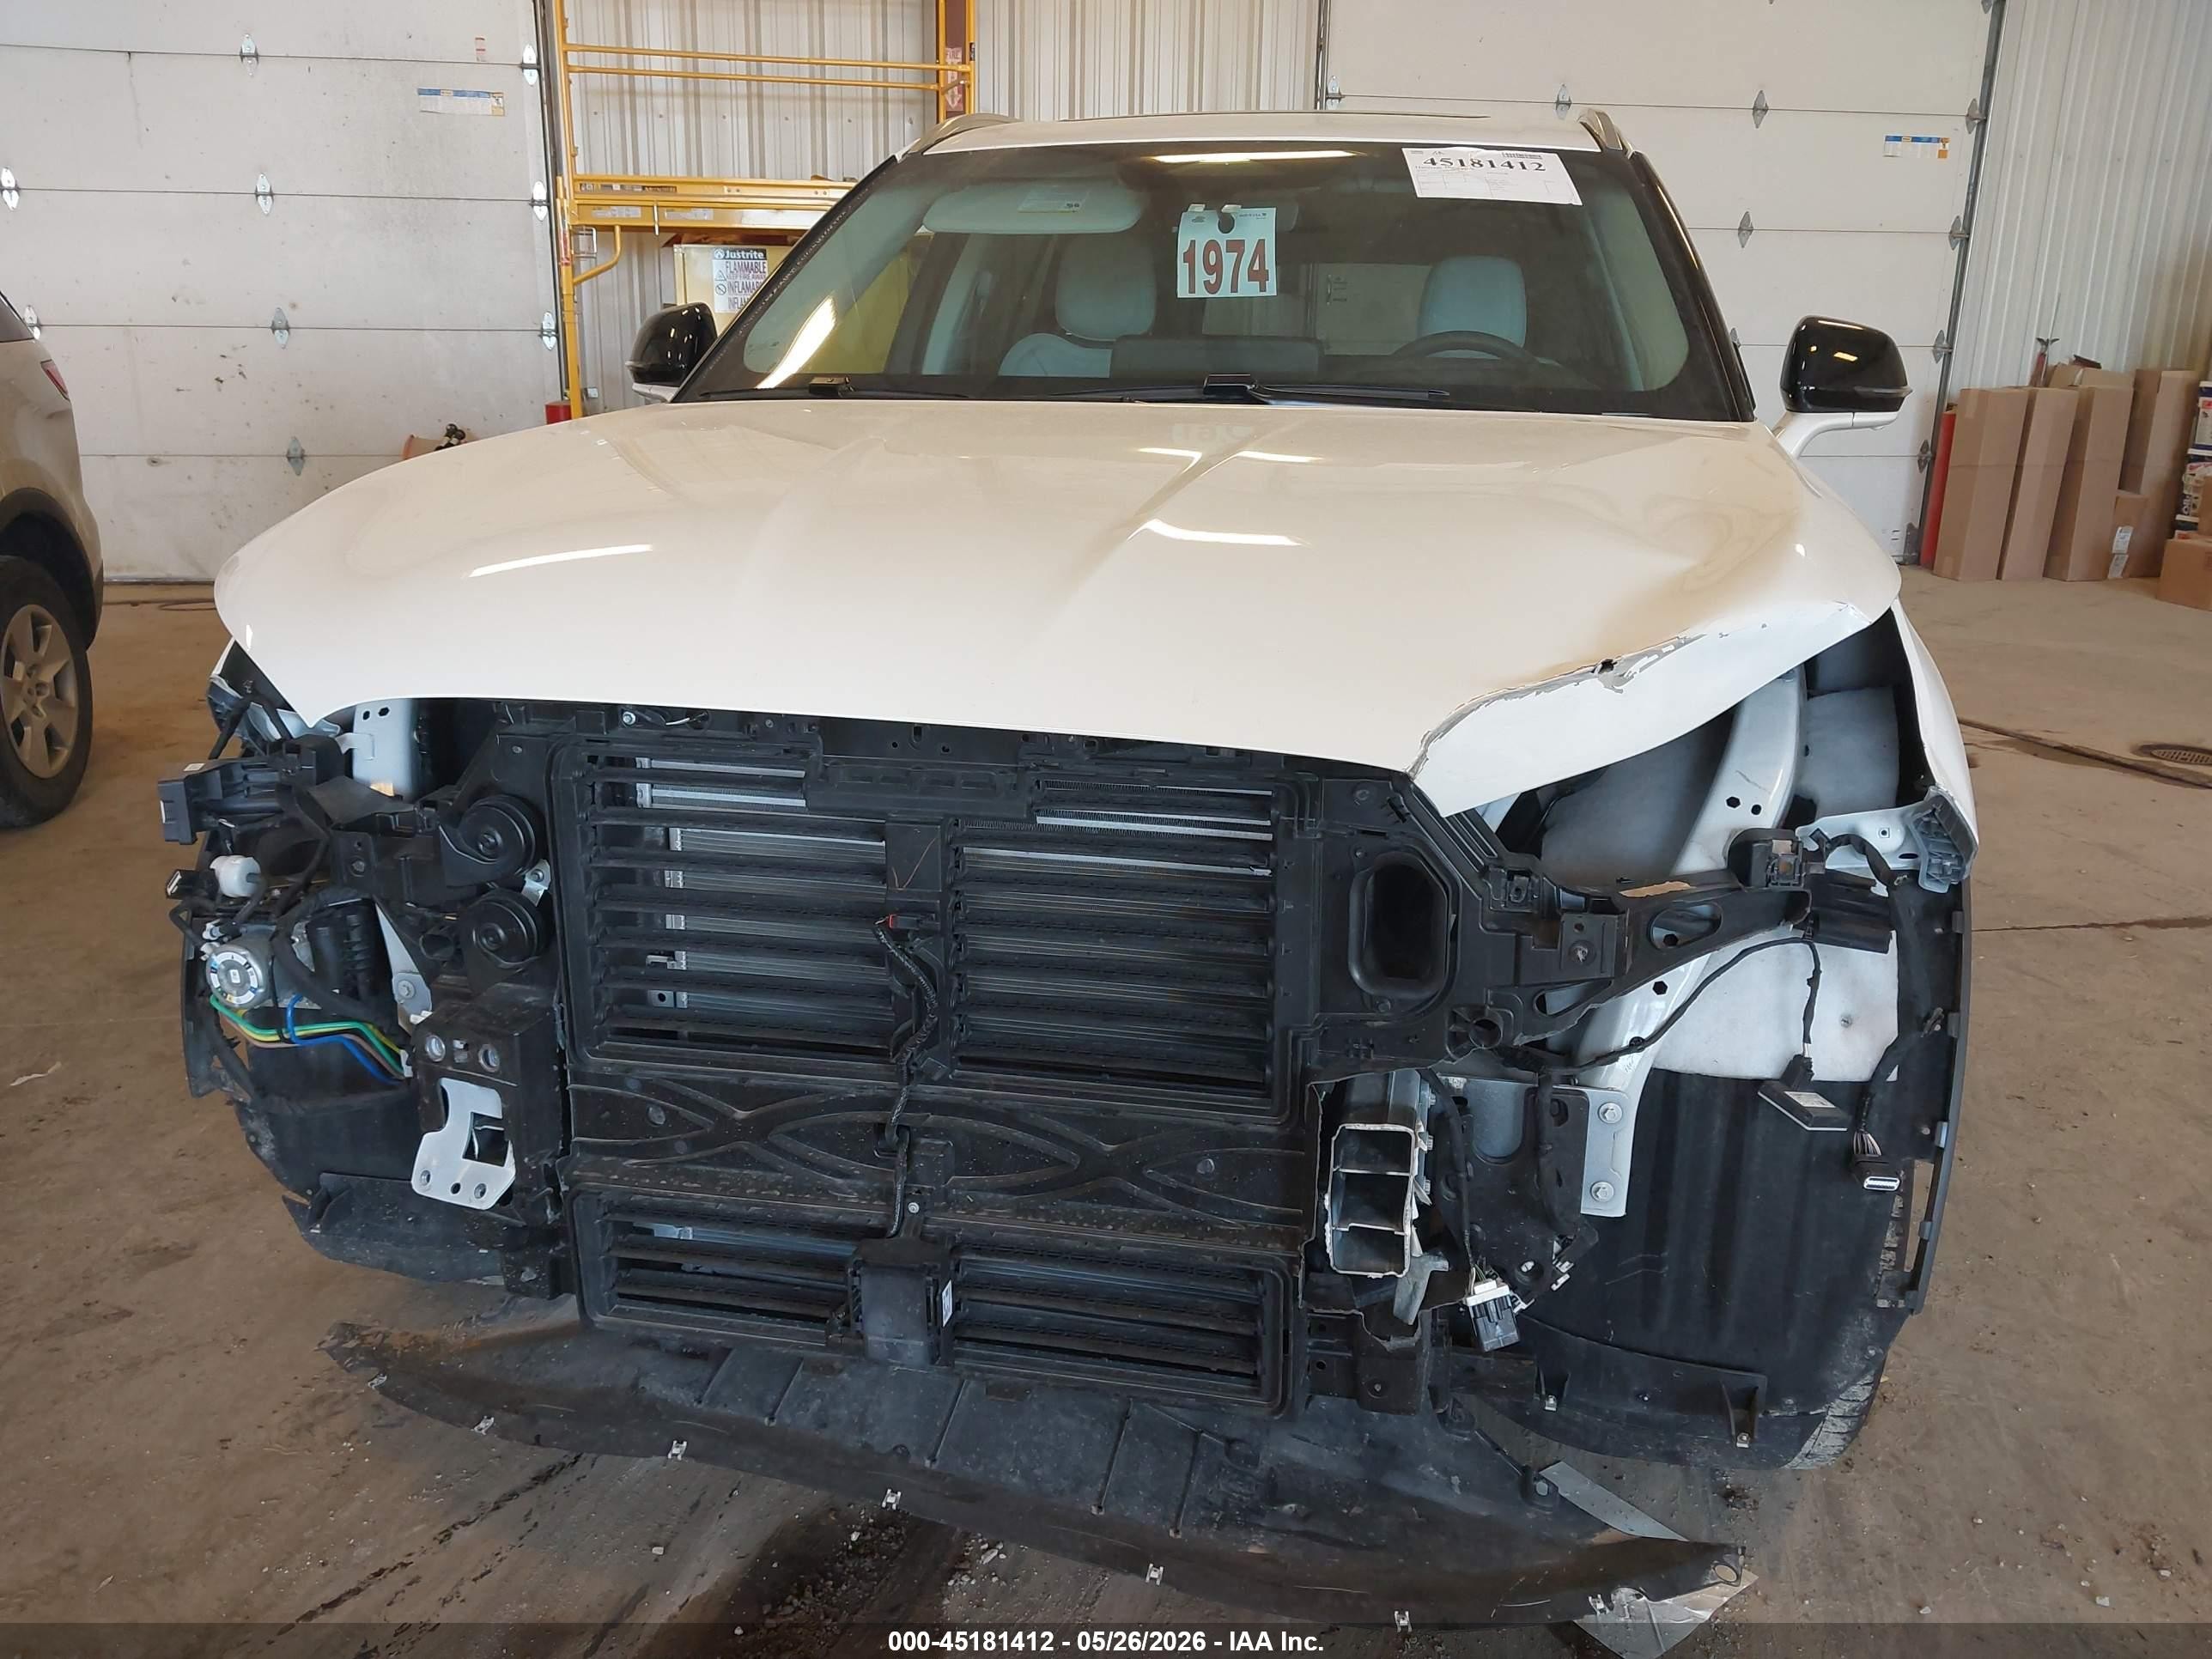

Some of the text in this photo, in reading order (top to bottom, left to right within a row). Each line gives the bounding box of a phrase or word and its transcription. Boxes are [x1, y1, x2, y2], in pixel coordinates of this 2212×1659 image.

[1423, 157, 1547, 172] 45181412
[725, 249, 765, 259] Justrite
[726, 260, 766, 274] FLAMMABLE
[1182, 239, 1269, 295] 1974
